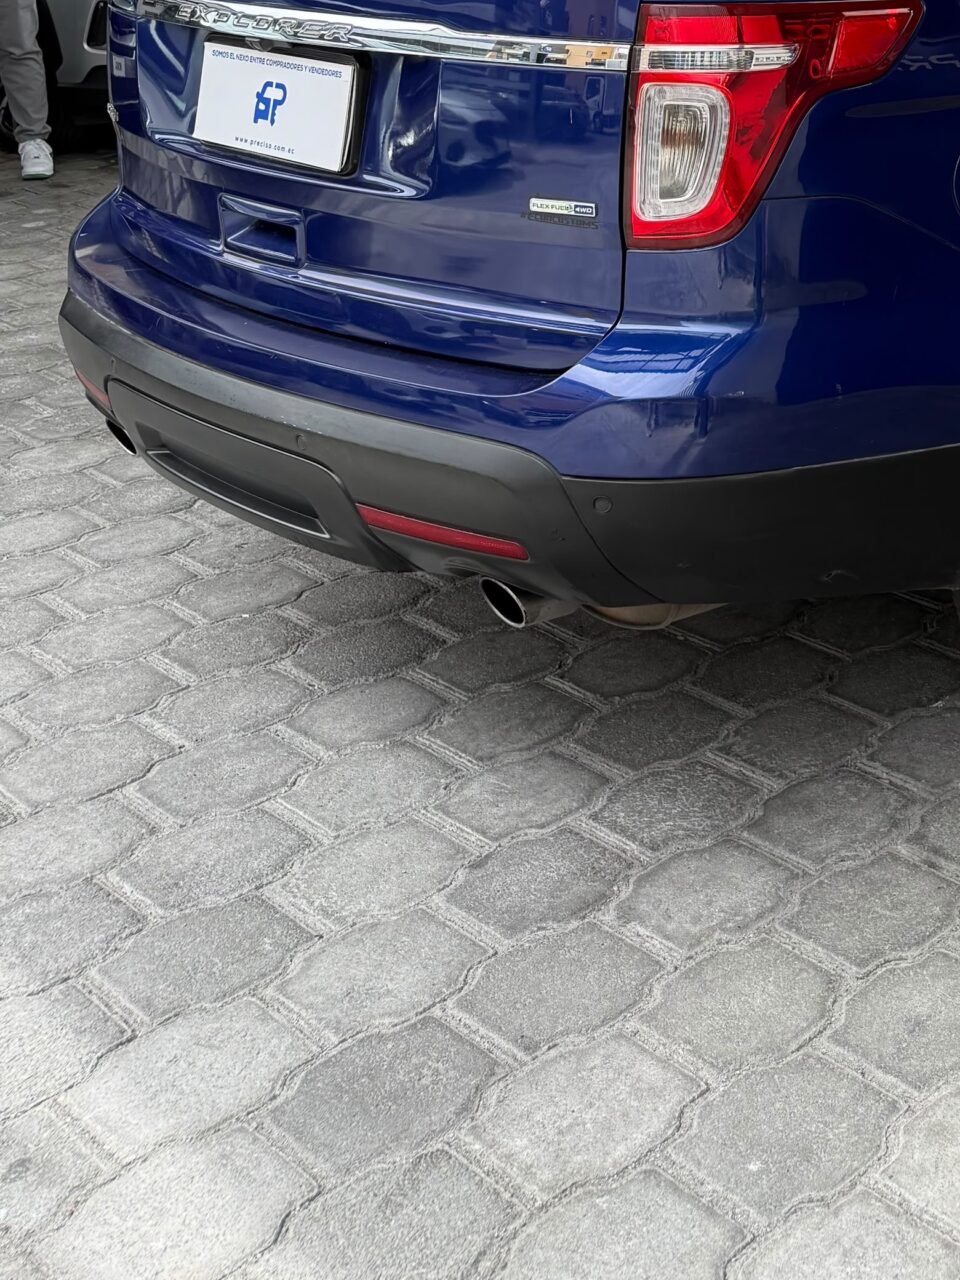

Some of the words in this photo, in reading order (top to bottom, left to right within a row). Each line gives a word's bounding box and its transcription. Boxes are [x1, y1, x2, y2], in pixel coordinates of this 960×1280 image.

[175, 3, 354, 42] EXPLORER
[211, 49, 230, 59] SOMOS
[229, 52, 236, 60] EL
[235, 53, 249, 62] NEXO
[249, 55, 266, 65] ENTRE
[265, 58, 304, 72] COMPRADORES
[308, 65, 343, 79] VENDEDORES
[532, 202, 551, 210] FLEX
